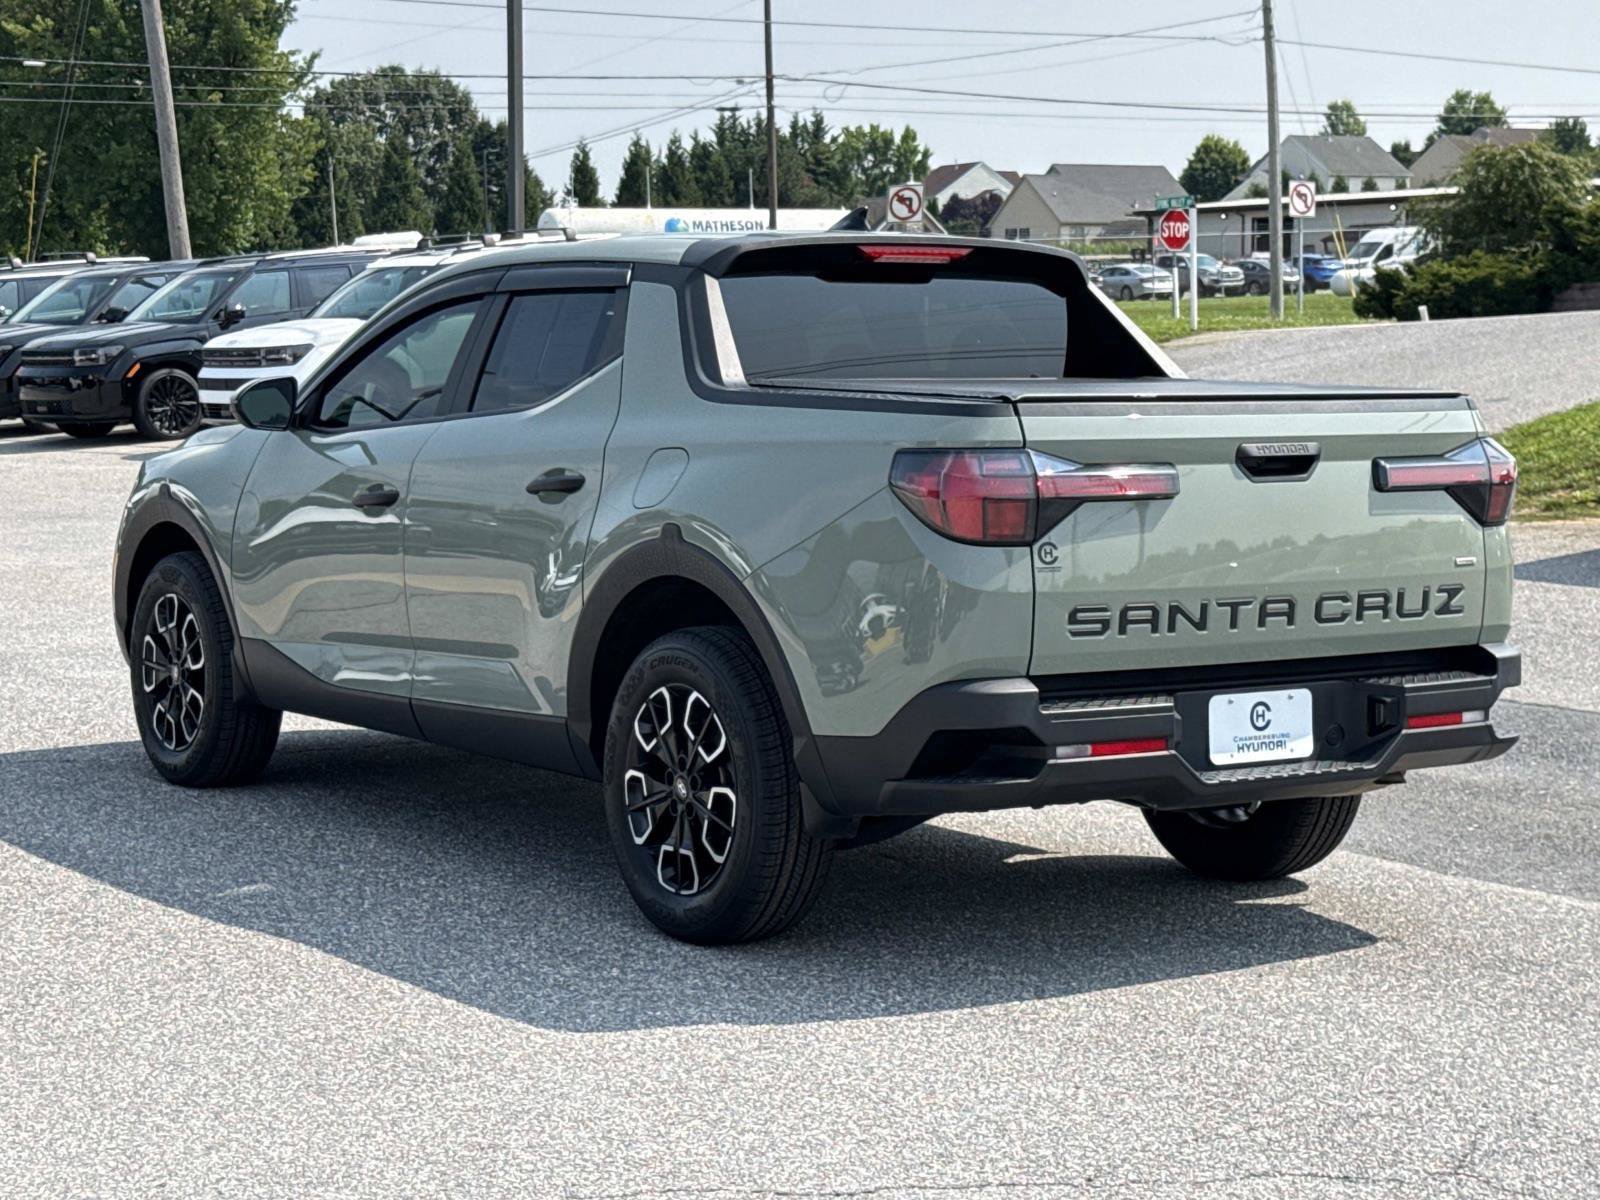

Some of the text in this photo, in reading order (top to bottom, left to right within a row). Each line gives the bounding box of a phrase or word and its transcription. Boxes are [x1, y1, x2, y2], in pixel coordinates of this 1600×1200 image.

[692, 220, 764, 233] MATHESON
[1162, 221, 1190, 238] STOP
[1255, 443, 1311, 455] HYUNDAI
[1066, 583, 1466, 640] SANTA CRUZ
[1237, 740, 1287, 754] HYUNDAI
